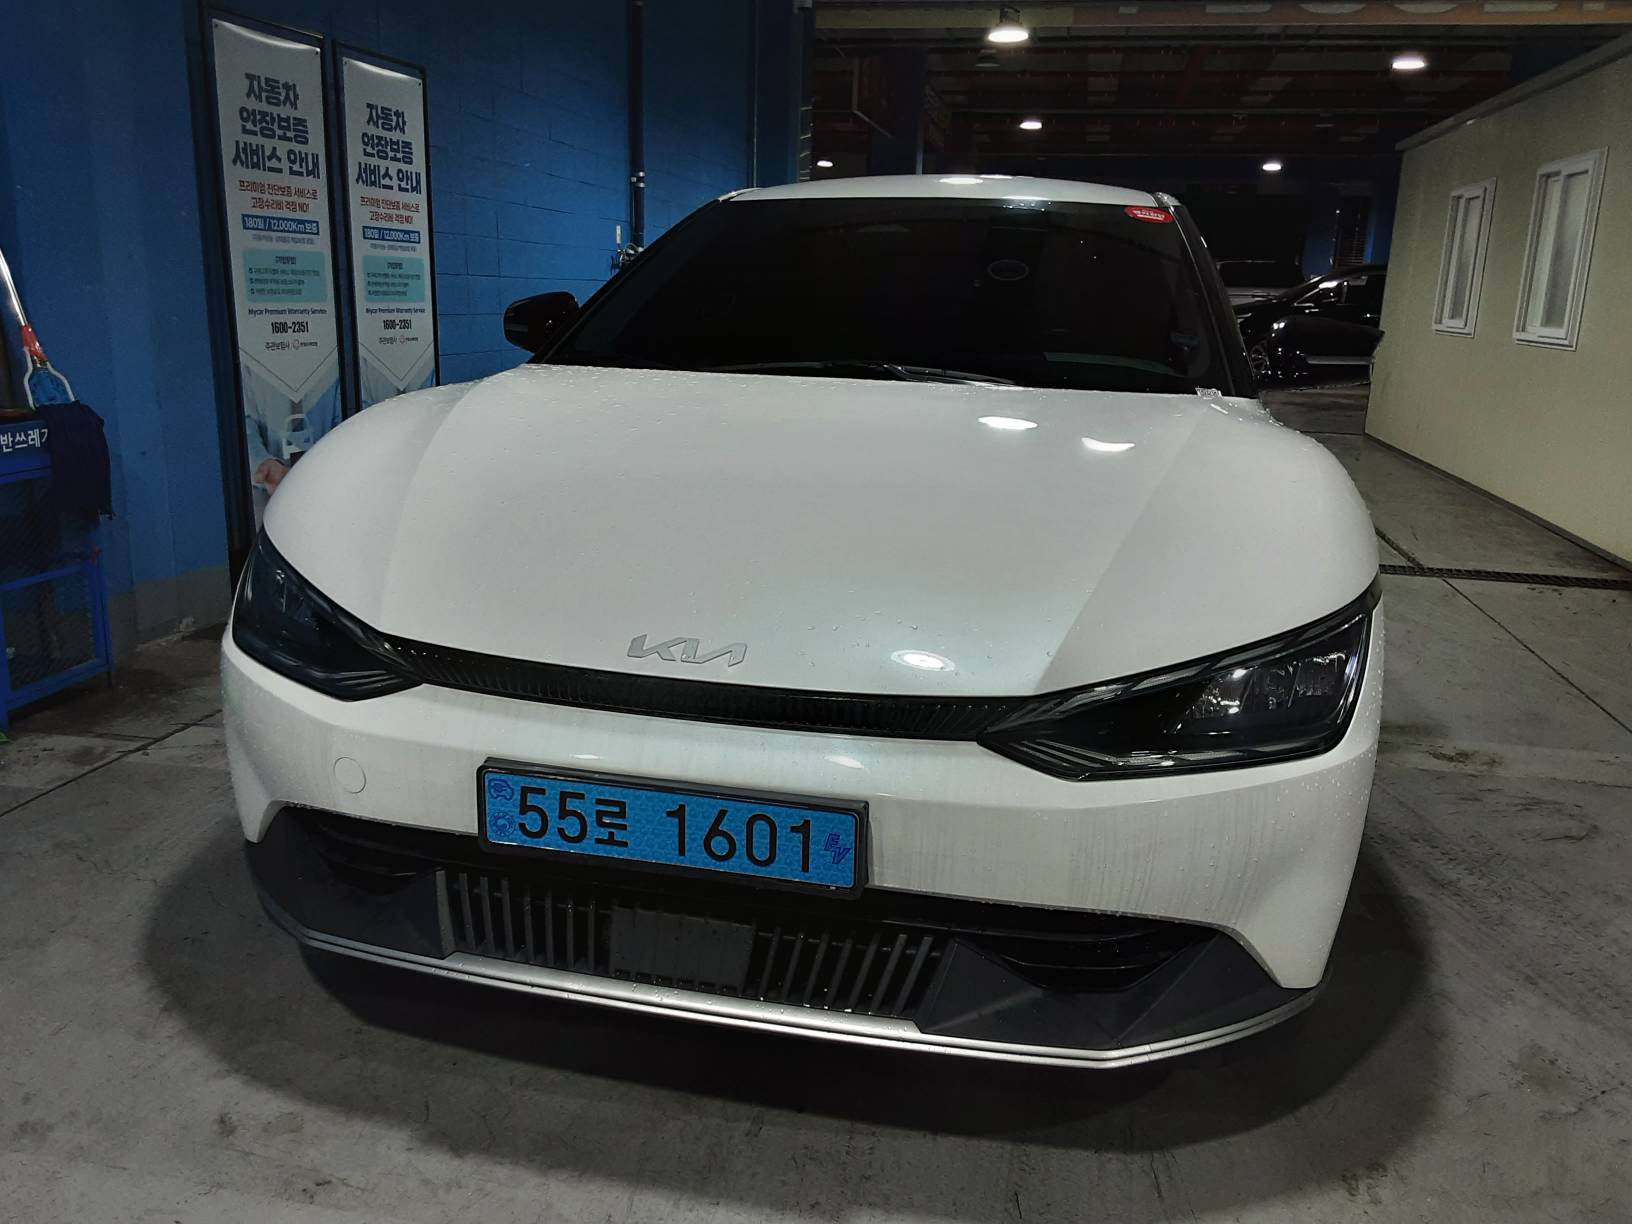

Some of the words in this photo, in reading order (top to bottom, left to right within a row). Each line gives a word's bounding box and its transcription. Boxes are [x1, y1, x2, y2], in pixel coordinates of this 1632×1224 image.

[245, 72, 299, 111] 자동차
[239, 106, 309, 145] 연장보증
[366, 102, 406, 135] 자동차
[232, 140, 283, 174] 서비스
[287, 148, 320, 179] 안내
[361, 132, 413, 165] 연장보증
[294, 187, 318, 200] 서비스로
[356, 161, 393, 190] 서비스
[396, 168, 422, 194] 안내
[271, 321, 309, 333] 1600-2351
[627, 634, 748, 667] KIA
[518, 785, 629, 848] 55로
[665, 803, 812, 874] 1601
[824, 832, 852, 865] EV
